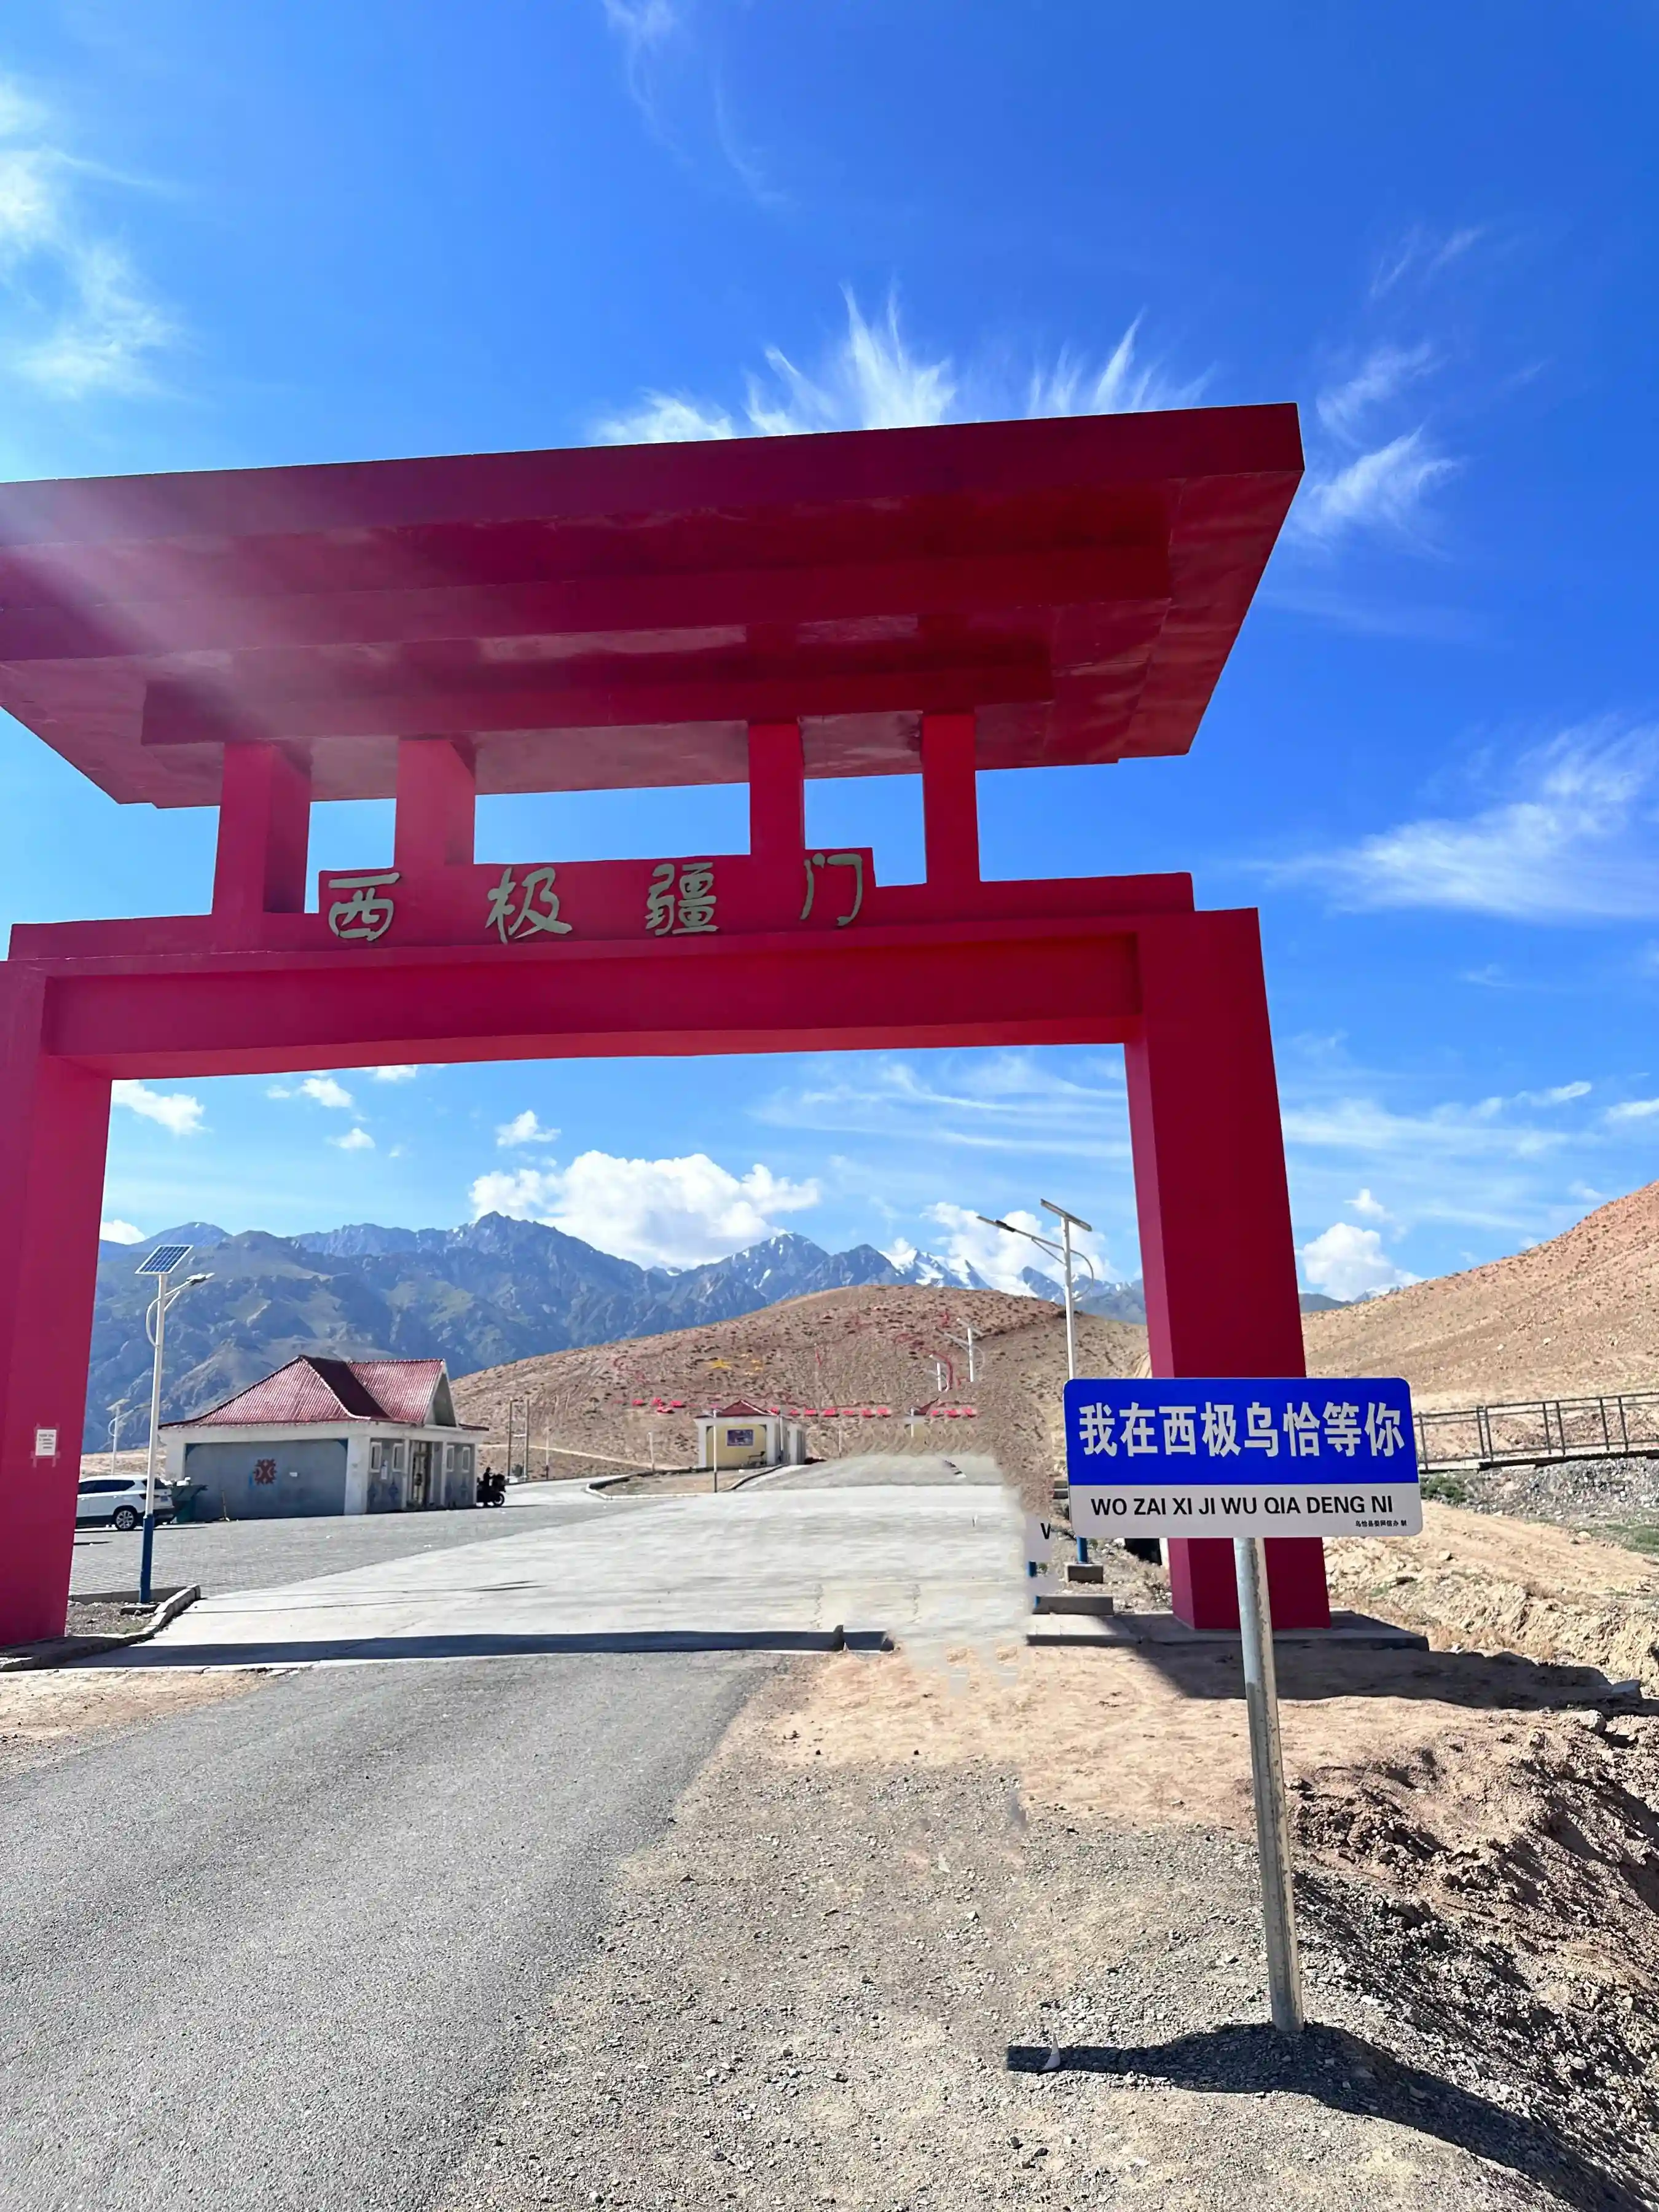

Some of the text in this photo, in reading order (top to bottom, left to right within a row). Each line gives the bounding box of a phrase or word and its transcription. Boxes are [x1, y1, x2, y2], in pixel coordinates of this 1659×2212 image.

[328, 853, 863, 945] 西极疆门
[1078, 1402, 1405, 1457] 我在西极乌恰等你
[1091, 1496, 1393, 1515] WO ZAI XI JI WU QIA DENG NI
